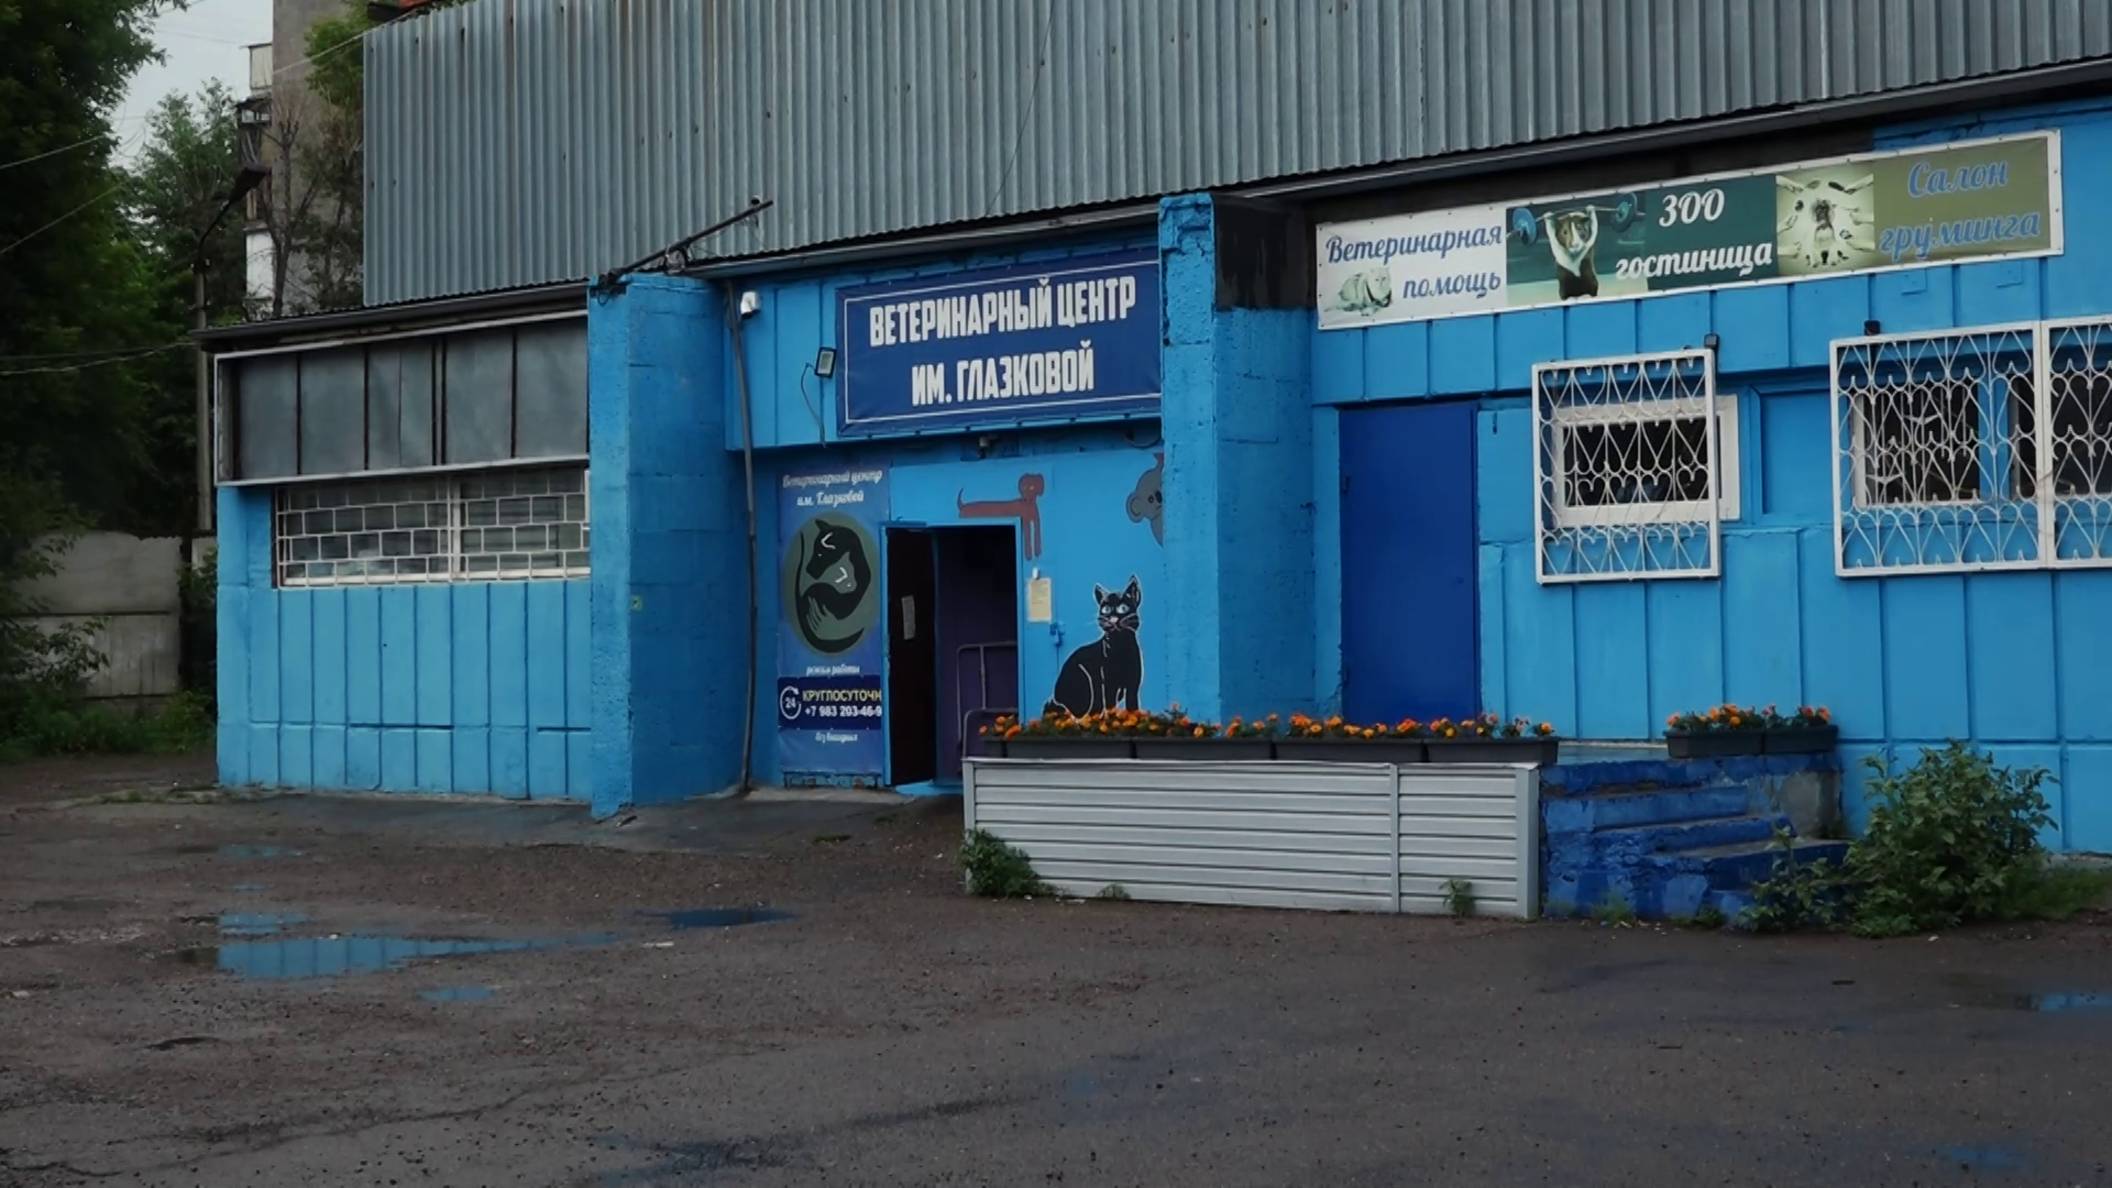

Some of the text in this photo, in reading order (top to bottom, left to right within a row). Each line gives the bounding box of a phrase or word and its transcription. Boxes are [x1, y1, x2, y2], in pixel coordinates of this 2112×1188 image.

[1908, 161, 2008, 198] Салон
[1325, 225, 1502, 265] Ветеринарная
[1880, 212, 2041, 263] груминга
[1615, 242, 1773, 280] гостиница
[1402, 272, 1501, 299] помощь
[869, 275, 1136, 347] ВЕТЕРИНАРНЫЙ ЦЕНТР
[912, 339, 1095, 407] ИМ. ГЛАЗКОВОЙ
[805, 705, 817, 717] +7
